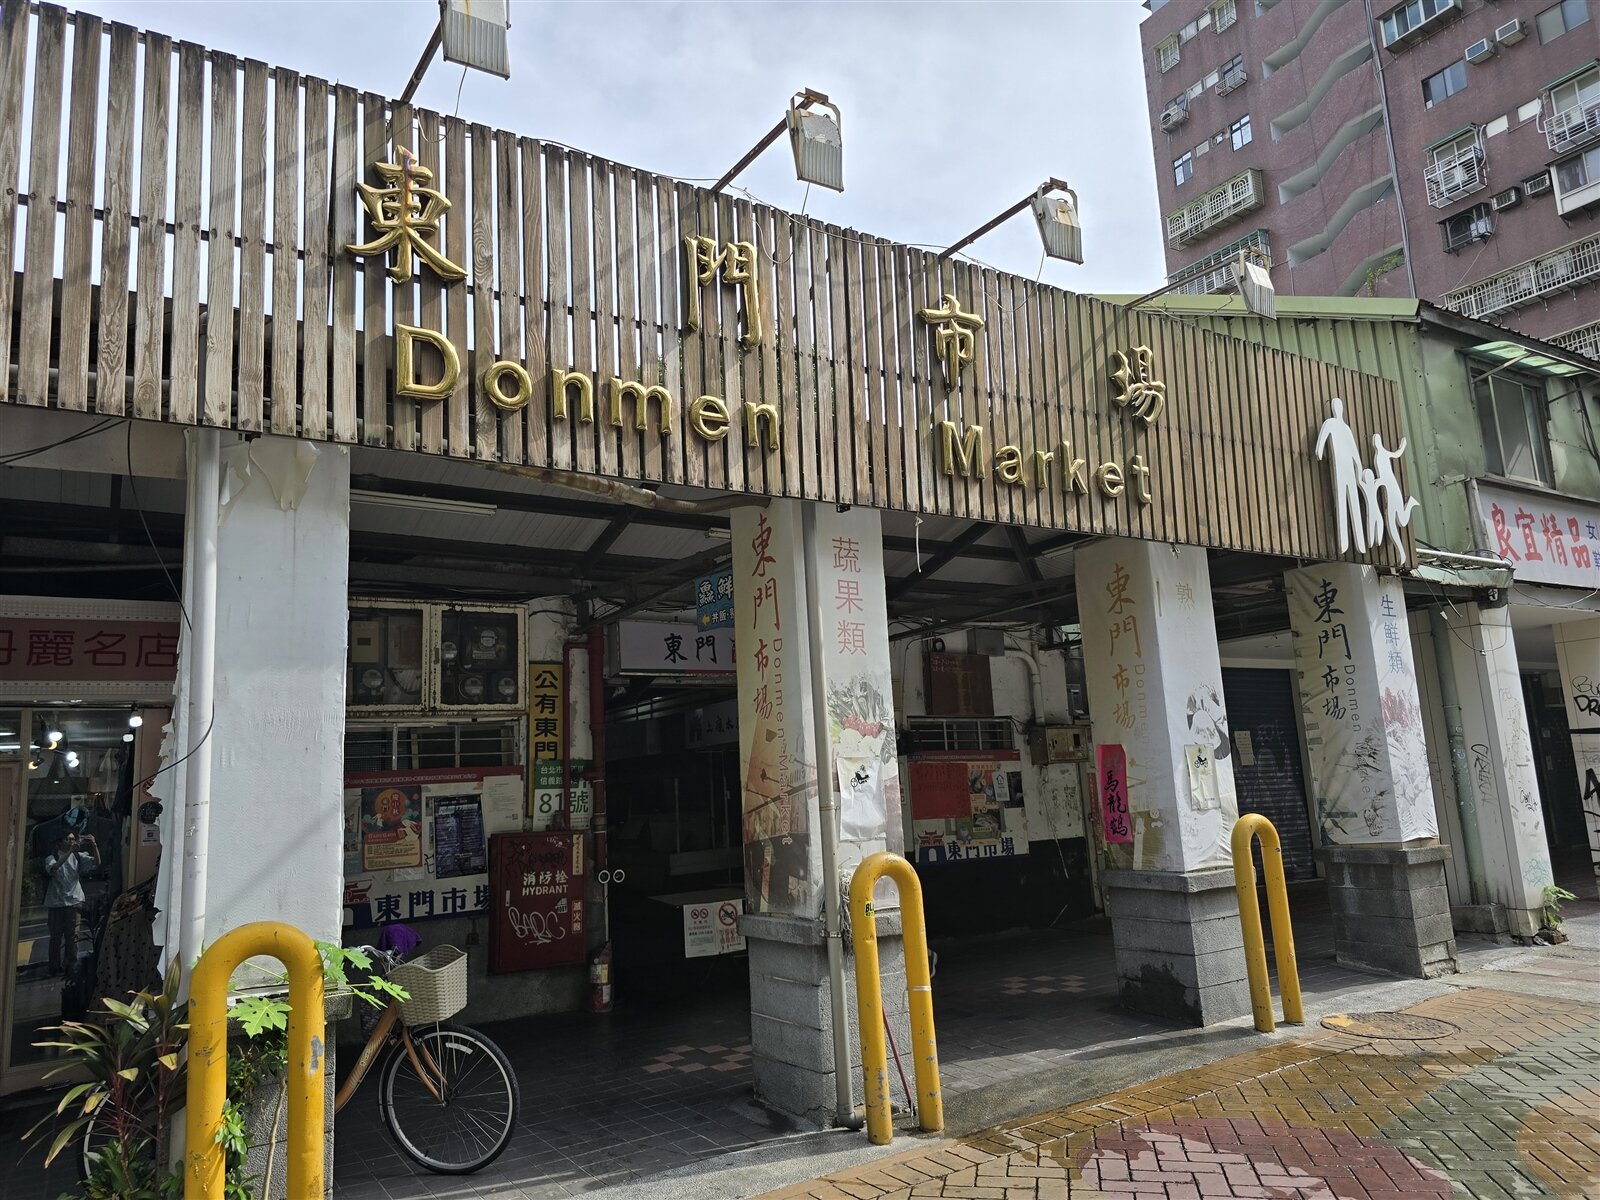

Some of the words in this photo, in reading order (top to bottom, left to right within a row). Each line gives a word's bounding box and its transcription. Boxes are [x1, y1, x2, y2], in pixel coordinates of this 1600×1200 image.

[396, 323, 780, 451] Donmen
[940, 420, 1153, 504] Market
[1490, 502, 1592, 569] 良宜精品
[750, 512, 781, 721] 東門市場
[831, 536, 868, 656] 蔬果類
[1379, 593, 1405, 675] 生鮮類
[663, 632, 736, 664] 東門
[772, 637, 788, 741] Donmen
[1105, 562, 1142, 729] 東門市場
[1312, 578, 1353, 721] 東門市場
[534, 670, 559, 760] 公有東門
[1343, 663, 1363, 733] Donmen
[521, 884, 569, 897] HYDRANT
[522, 870, 569, 886] 消防栓
